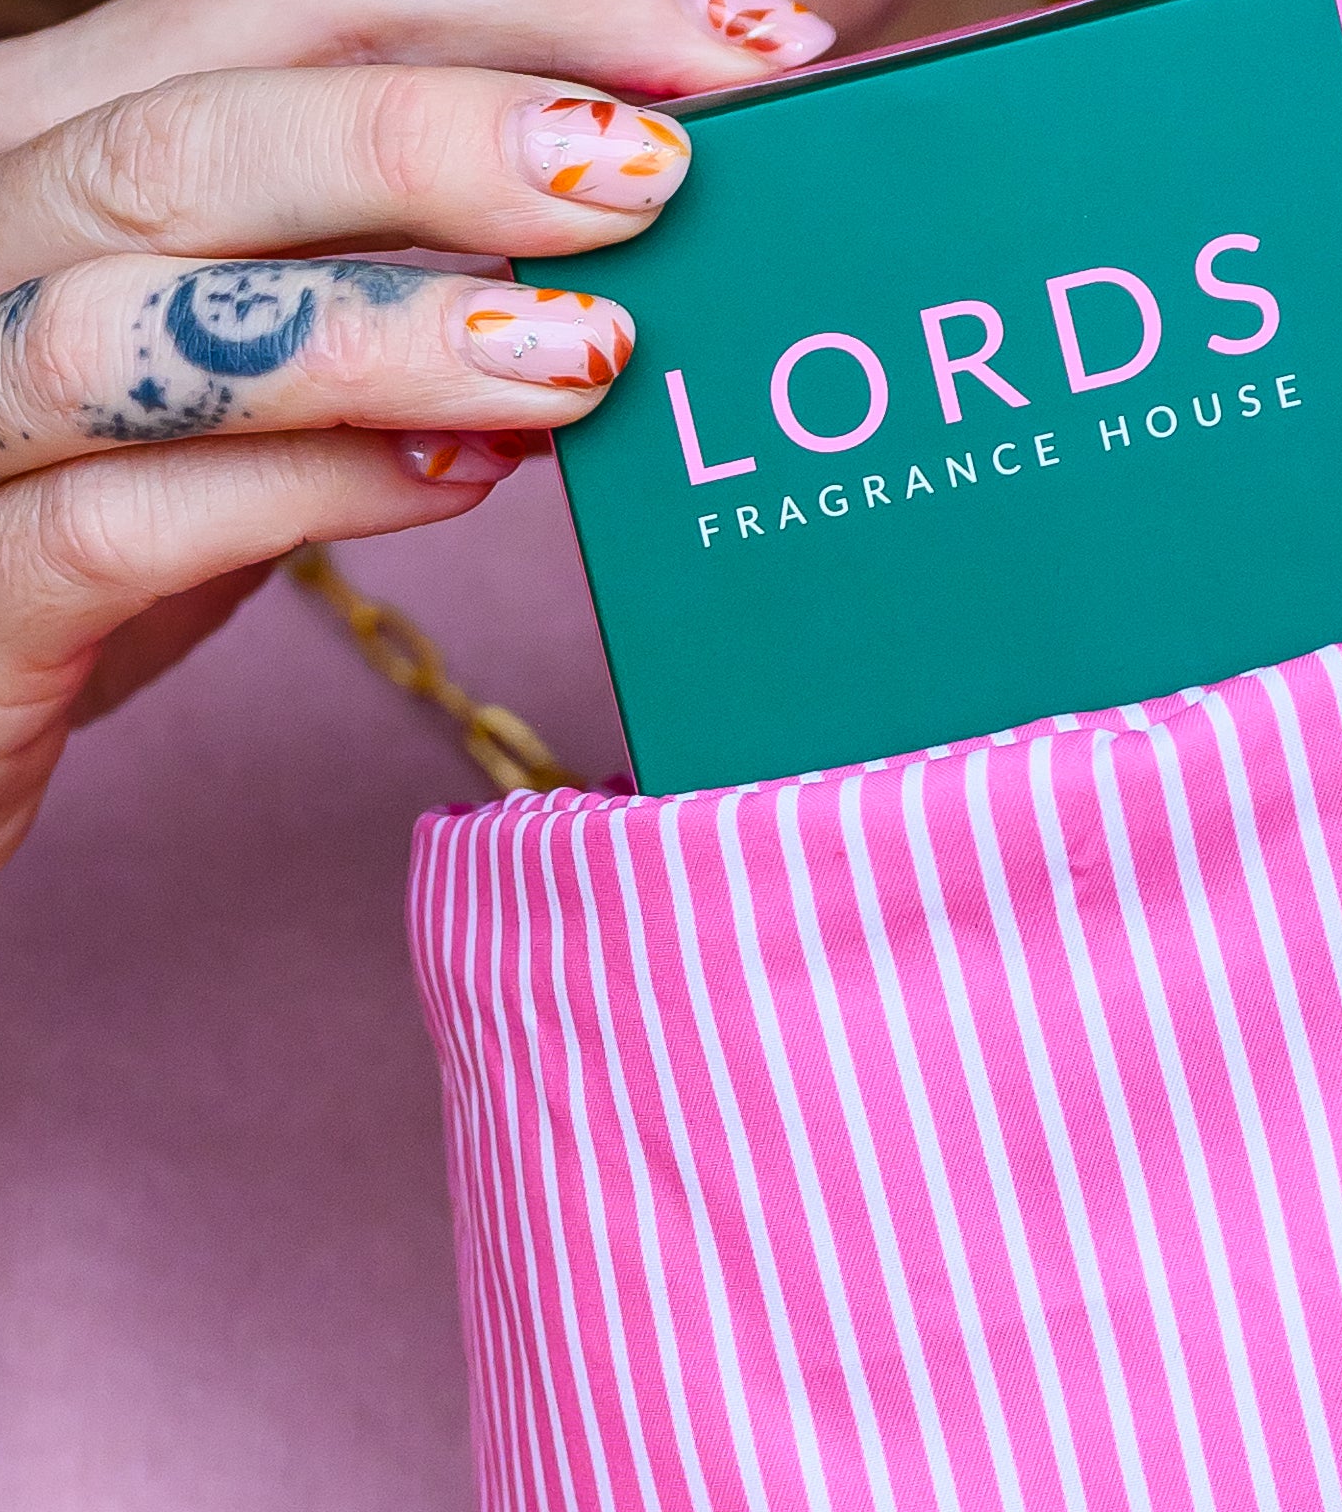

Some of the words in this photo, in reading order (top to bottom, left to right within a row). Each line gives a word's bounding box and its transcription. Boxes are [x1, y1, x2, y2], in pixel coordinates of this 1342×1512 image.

[664, 233, 1281, 486] LORDS
[697, 432, 1061, 548] FRAGRANCE
[1099, 374, 1303, 451] HOUSE
